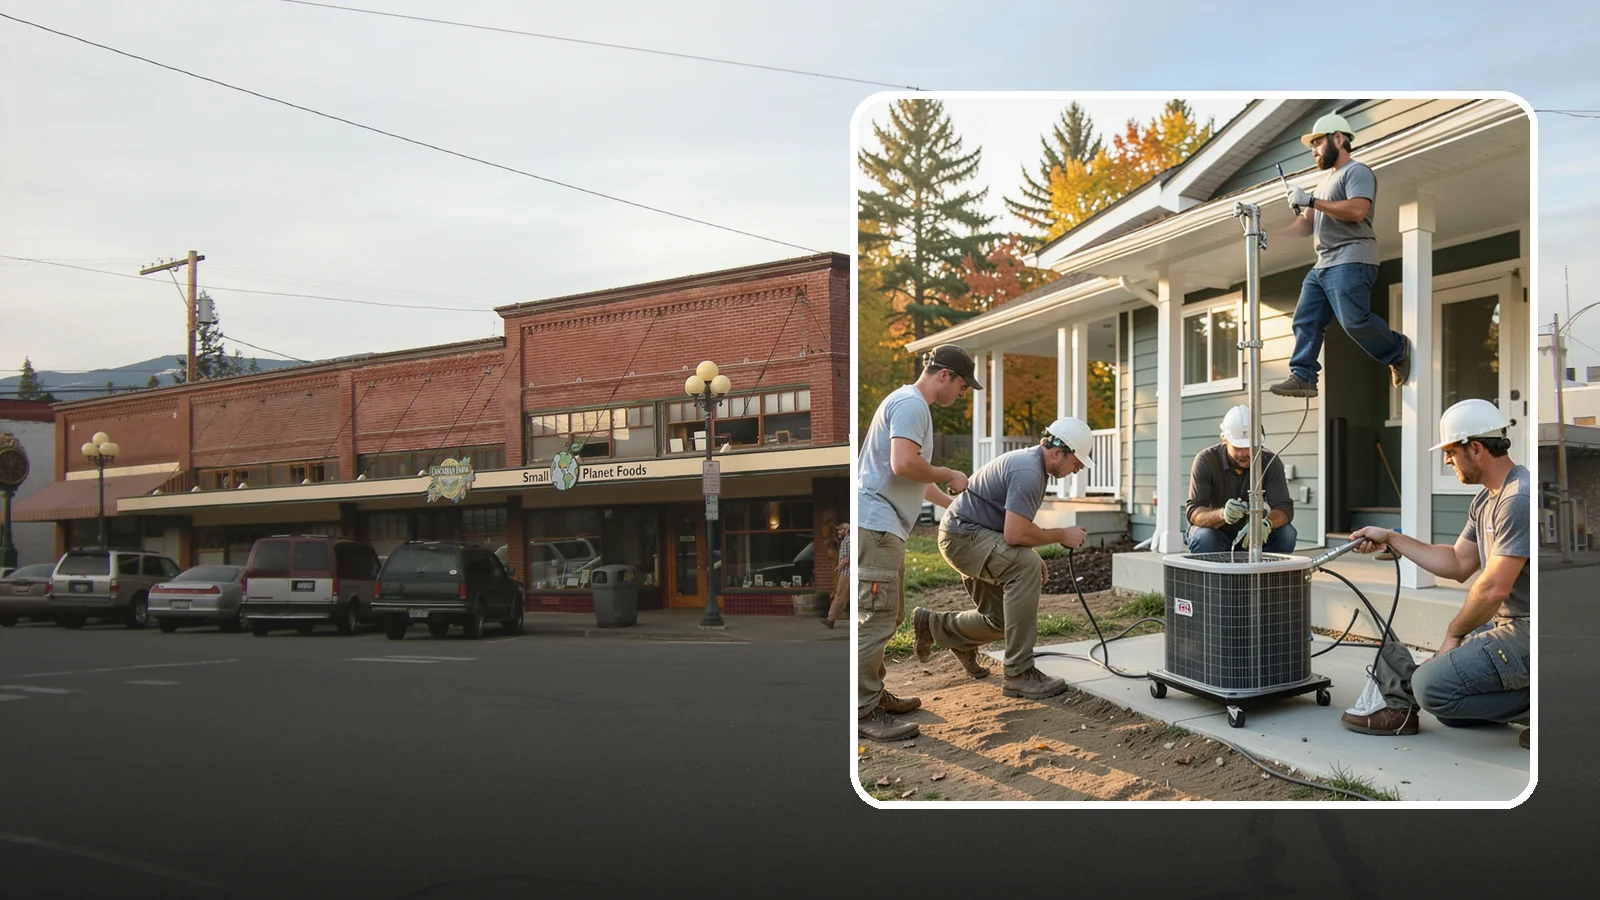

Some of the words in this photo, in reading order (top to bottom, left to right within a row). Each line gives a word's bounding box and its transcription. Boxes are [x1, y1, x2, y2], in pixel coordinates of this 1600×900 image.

[431, 467, 456, 476] CASCADIAN
[455, 465, 469, 474] FARM
[523, 470, 549, 483] Small
[582, 467, 614, 479] Planet
[616, 464, 647, 477] Foods
